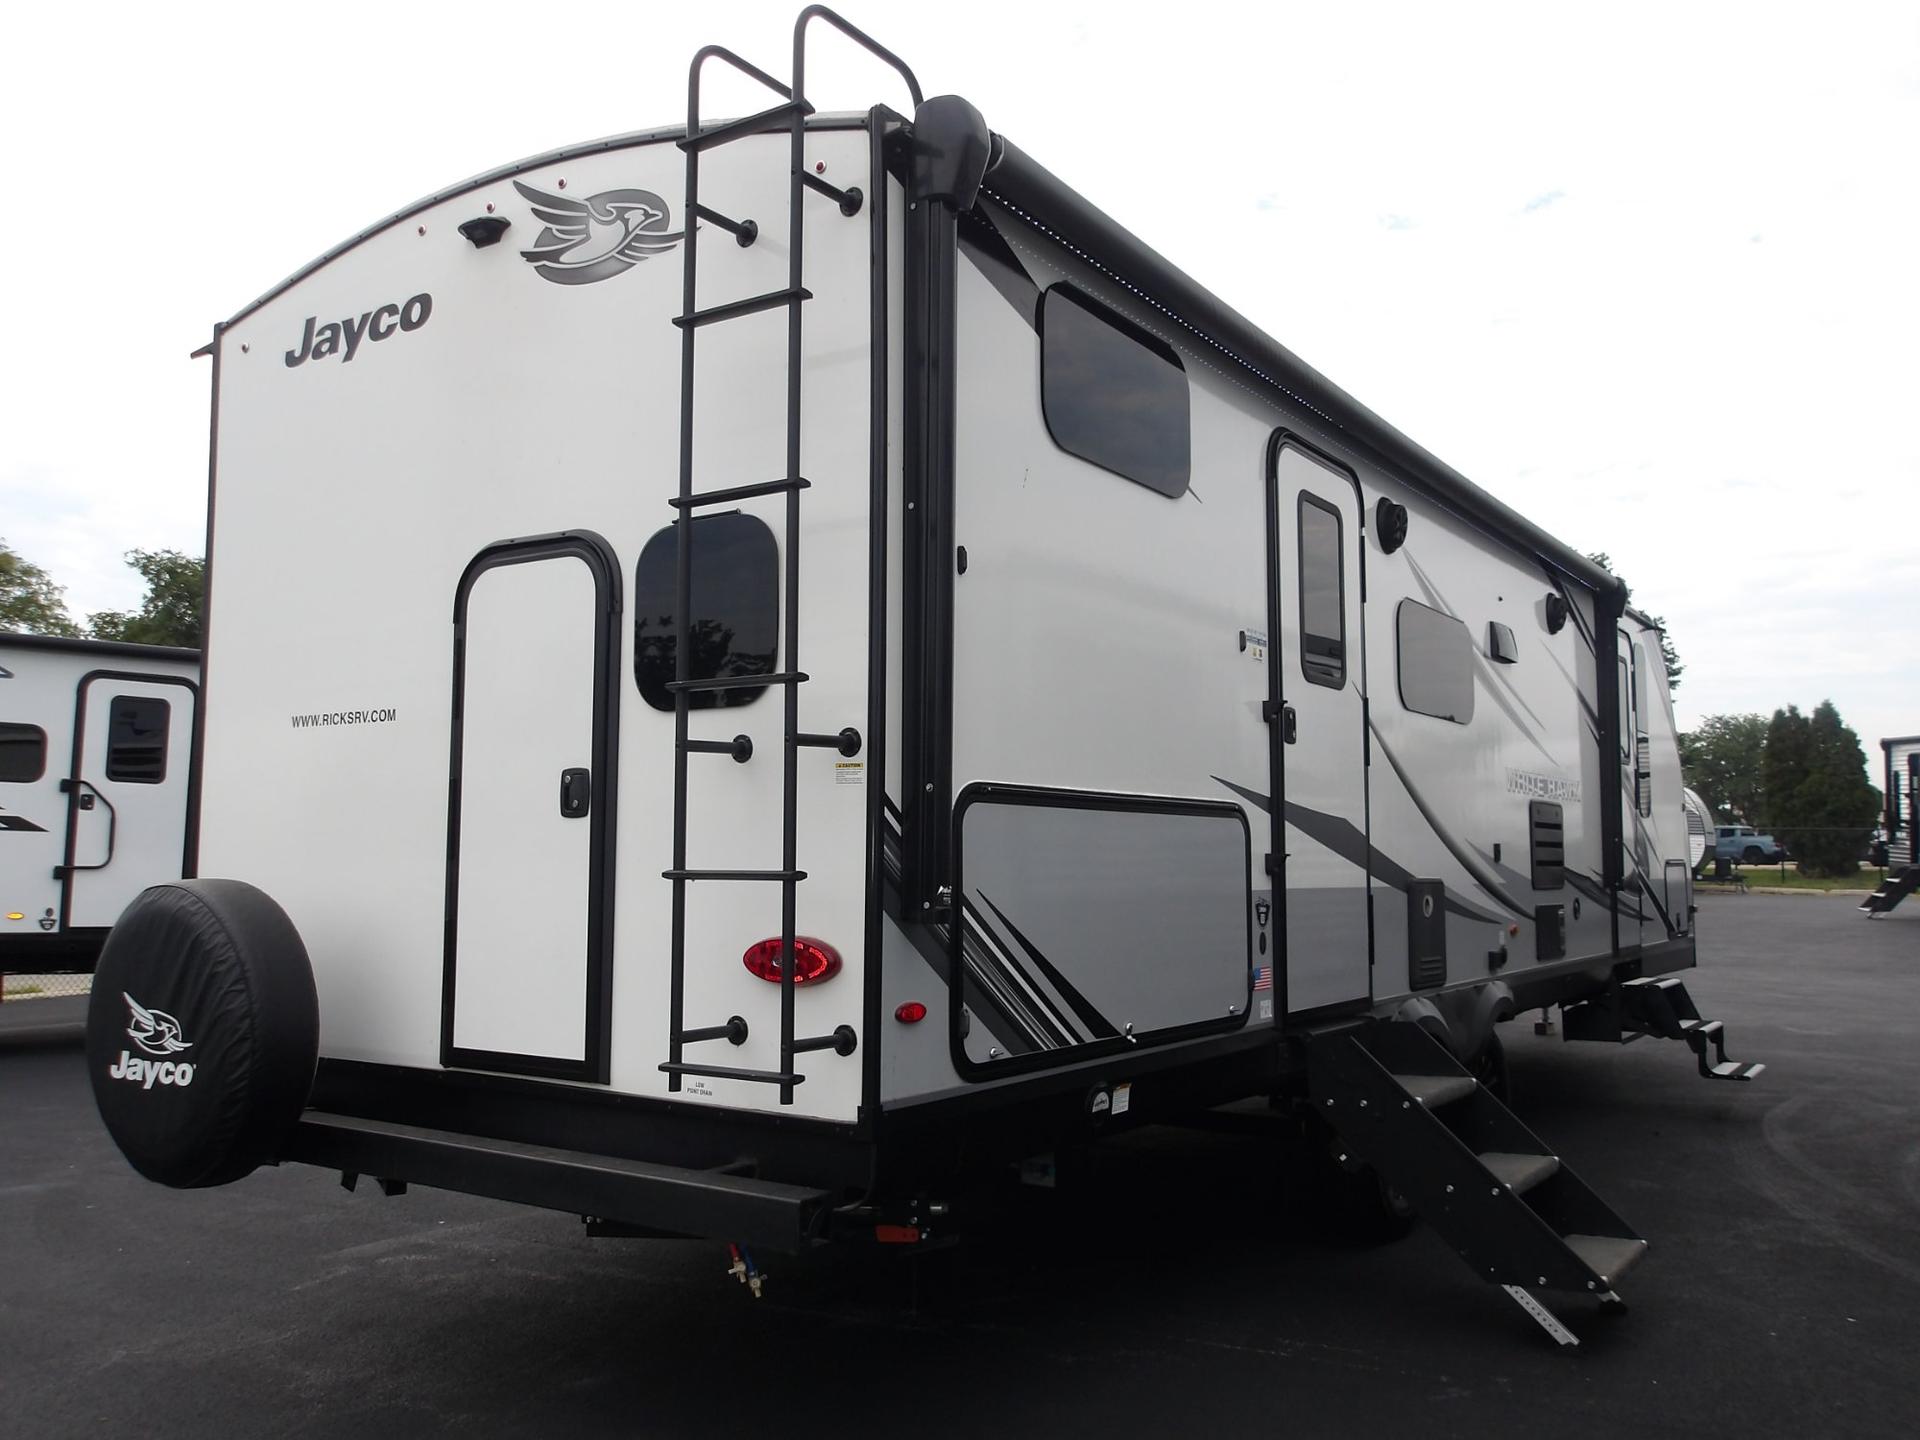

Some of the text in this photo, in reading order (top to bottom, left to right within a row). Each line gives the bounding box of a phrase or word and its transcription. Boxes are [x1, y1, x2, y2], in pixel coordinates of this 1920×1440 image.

[285, 293, 432, 368] Jayco
[291, 708, 396, 728] WWW.RICKSRV.COM
[110, 1050, 194, 1089] Jayco
